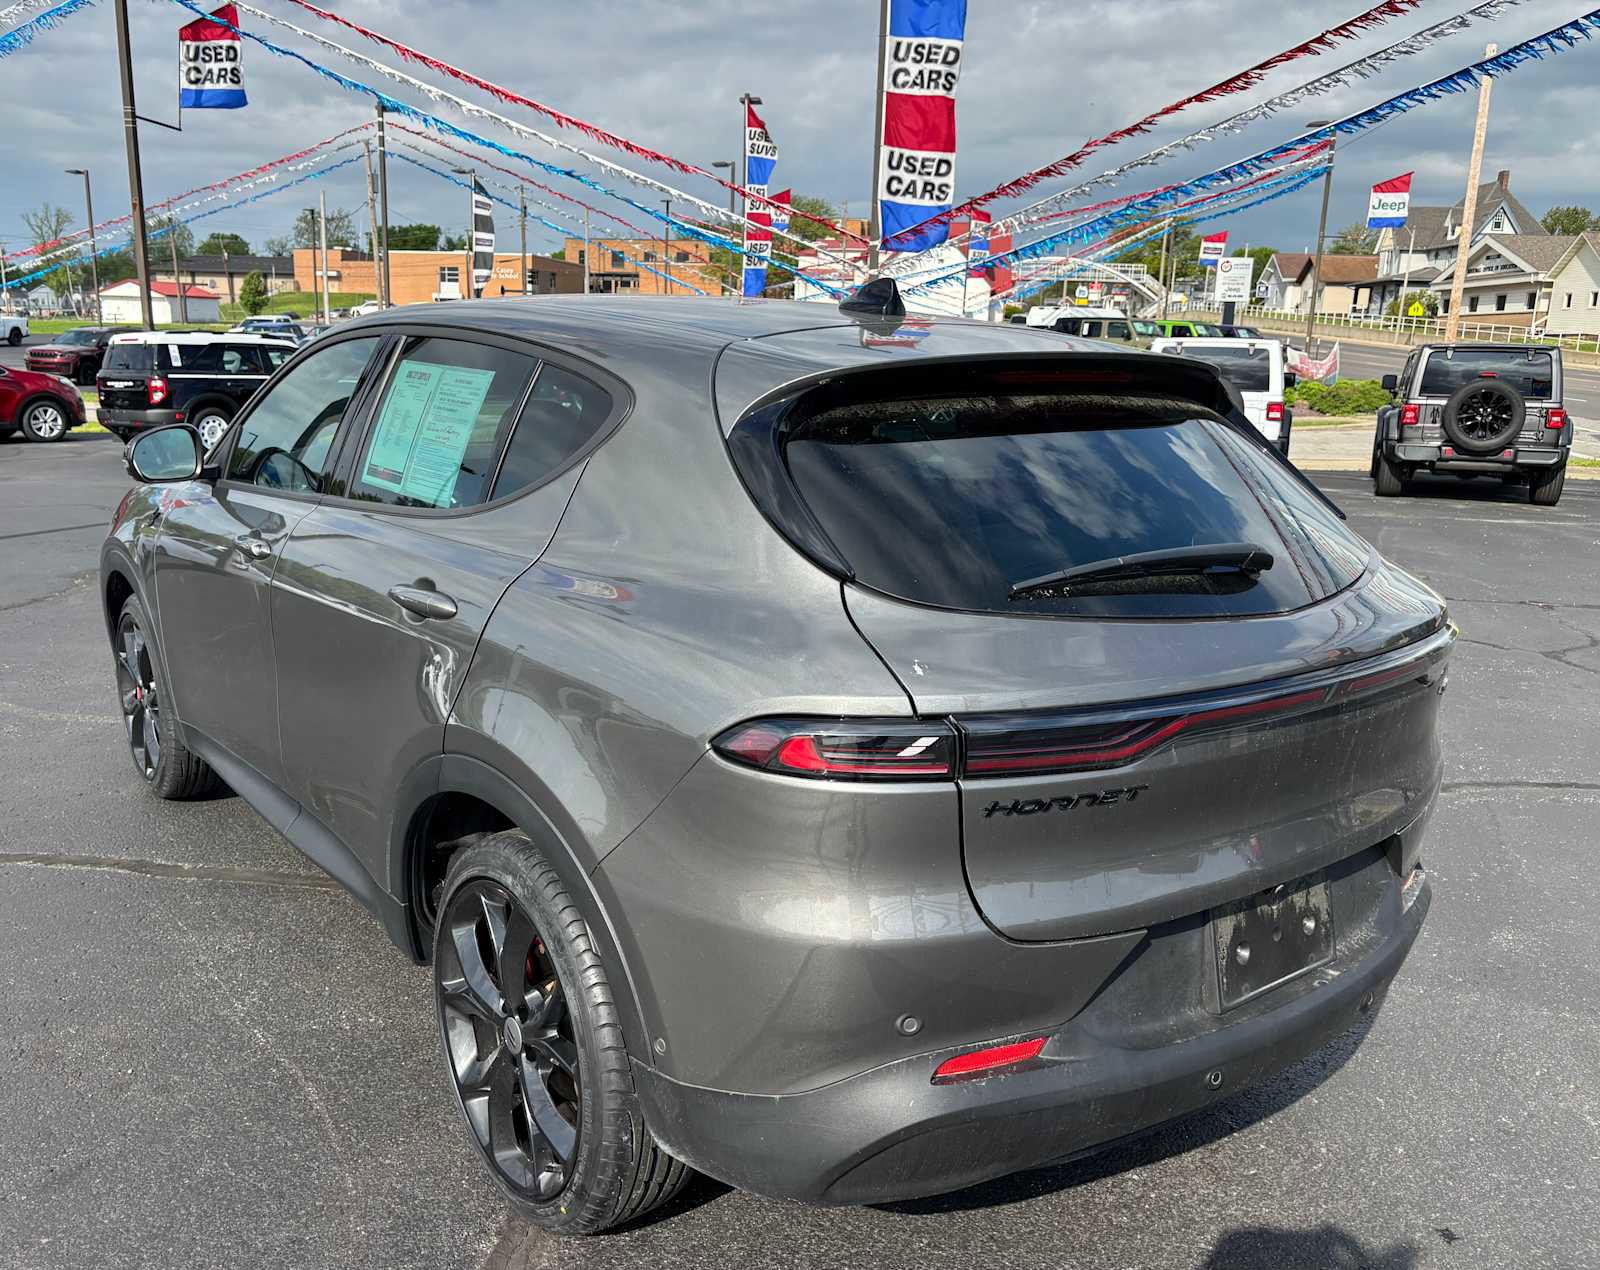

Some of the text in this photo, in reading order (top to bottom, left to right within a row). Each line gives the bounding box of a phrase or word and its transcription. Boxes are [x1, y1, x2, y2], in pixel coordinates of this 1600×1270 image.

[184, 45, 238, 63] USED
[893, 41, 960, 66] USED
[185, 66, 241, 85] CARS
[892, 67, 957, 92] CARS
[749, 130, 773, 143] USE
[749, 142, 778, 157] SUVS
[887, 151, 953, 178] USED
[886, 175, 951, 202] CARS
[1372, 198, 1406, 212] Jeep
[982, 784, 1150, 818] HORNET
